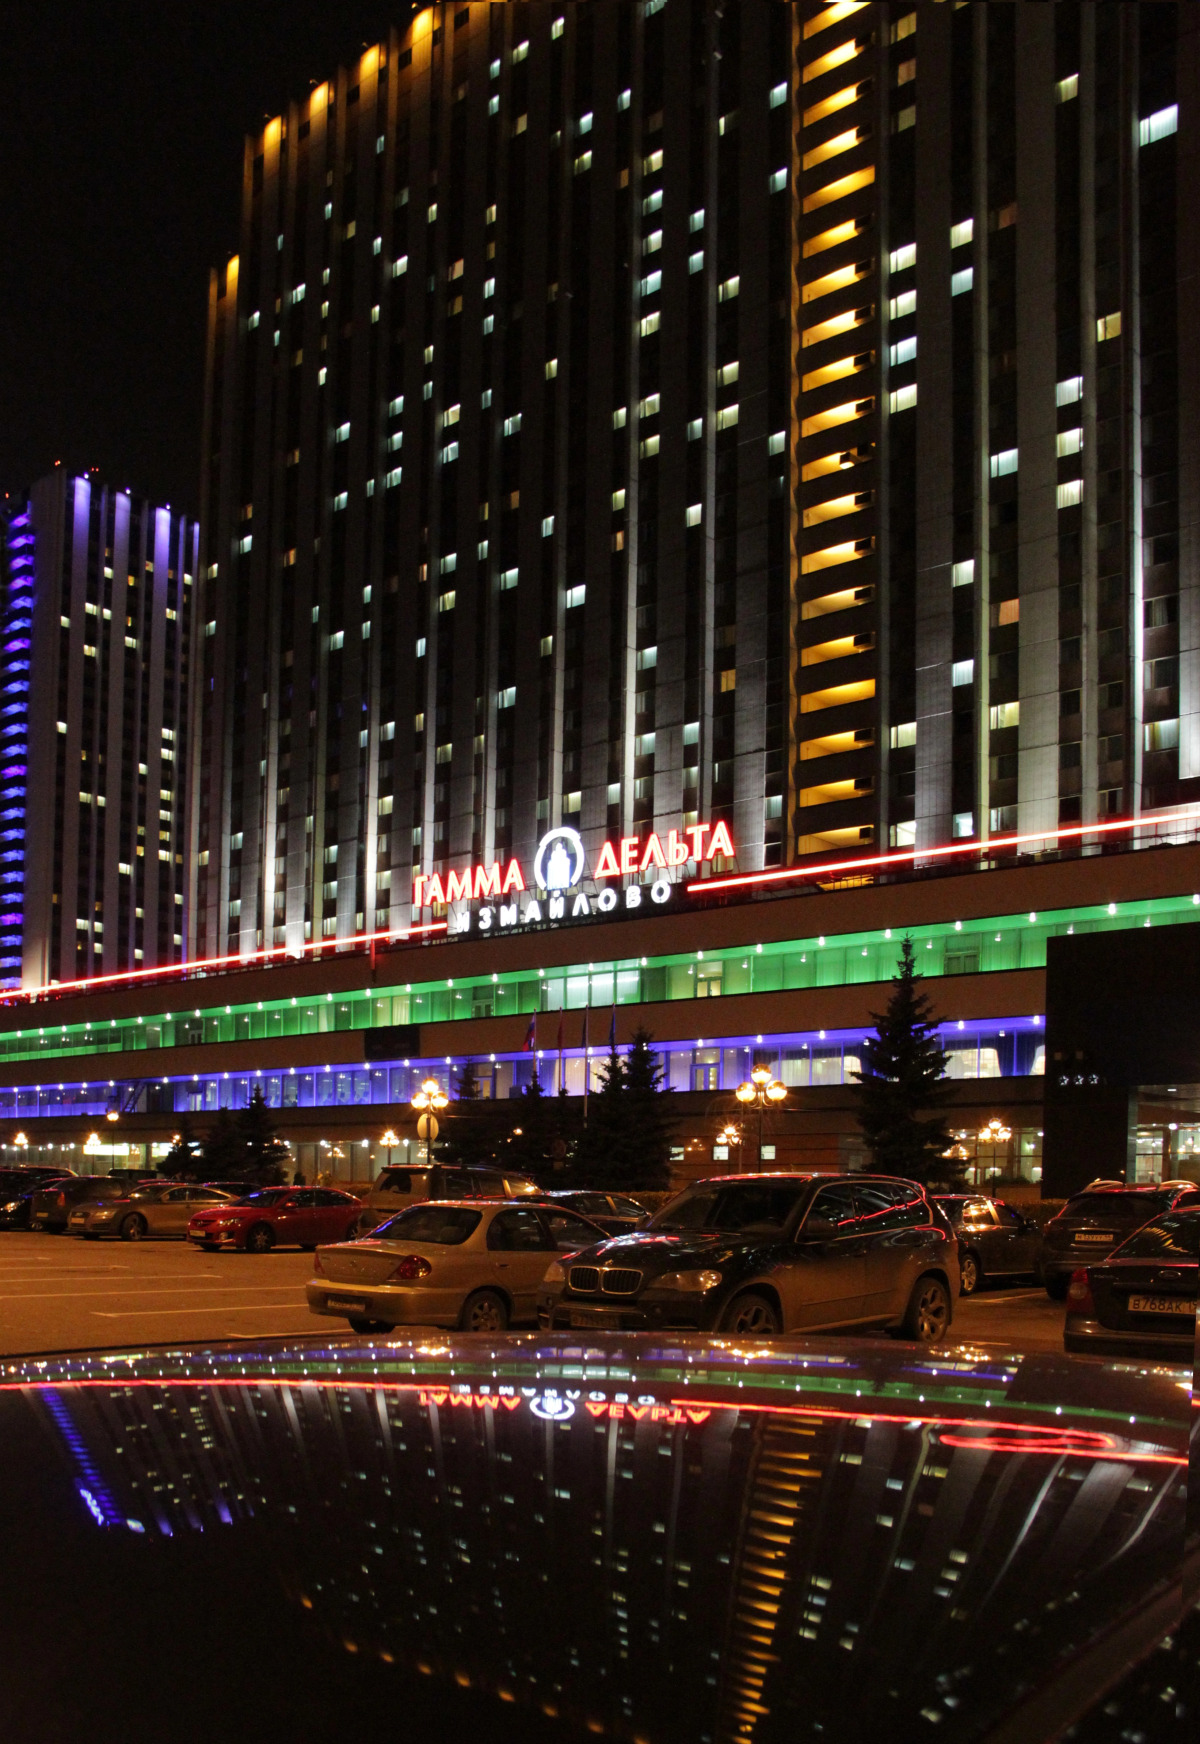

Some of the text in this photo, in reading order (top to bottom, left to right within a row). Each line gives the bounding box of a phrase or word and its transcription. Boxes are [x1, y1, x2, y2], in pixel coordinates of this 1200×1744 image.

[414, 820, 736, 908] ГАММА ДЕЛЬТА
[456, 880, 672, 933] ИЗМАЙЛОВО
